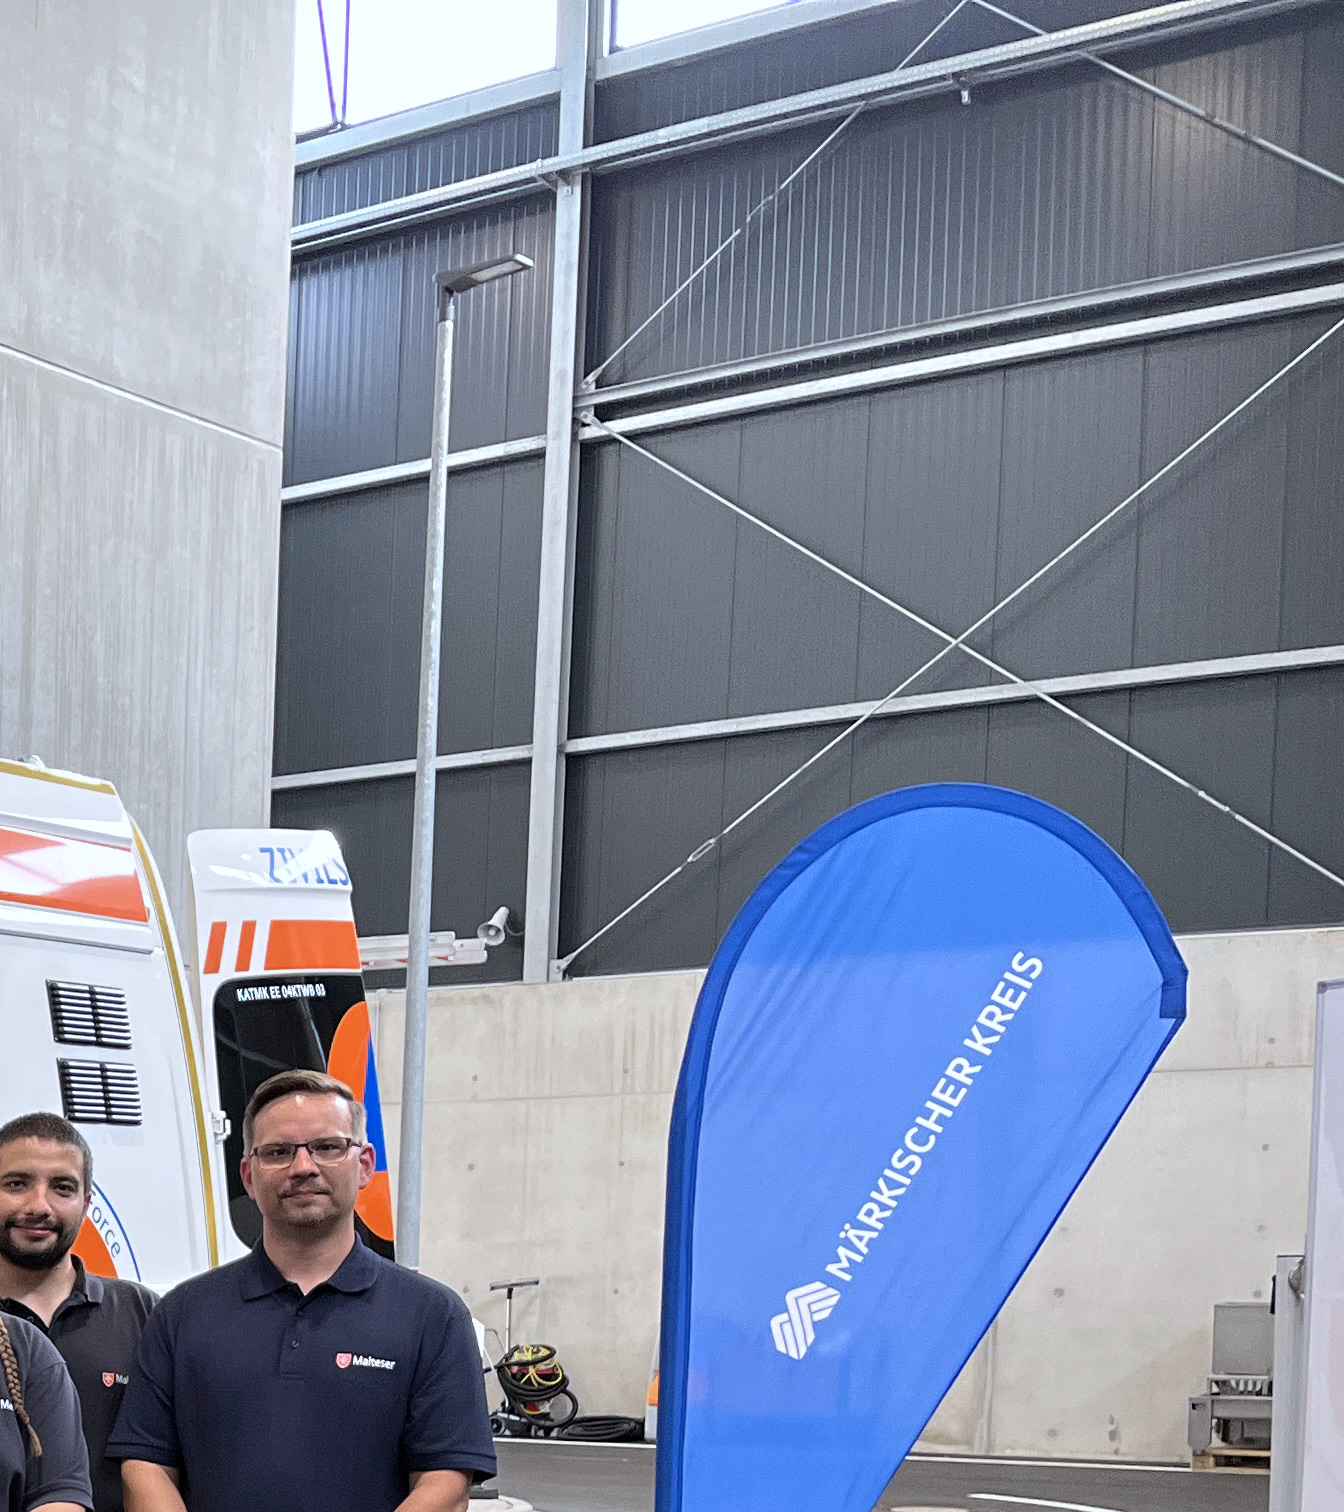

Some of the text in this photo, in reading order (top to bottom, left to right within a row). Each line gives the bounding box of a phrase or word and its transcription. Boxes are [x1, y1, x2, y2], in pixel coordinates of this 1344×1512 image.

[269, 985, 281, 999] EE
[825, 951, 1044, 1281] MÄRKISCHER KREIS
[90, 1189, 121, 1259] orce
[353, 1355, 395, 1369] Malteser
